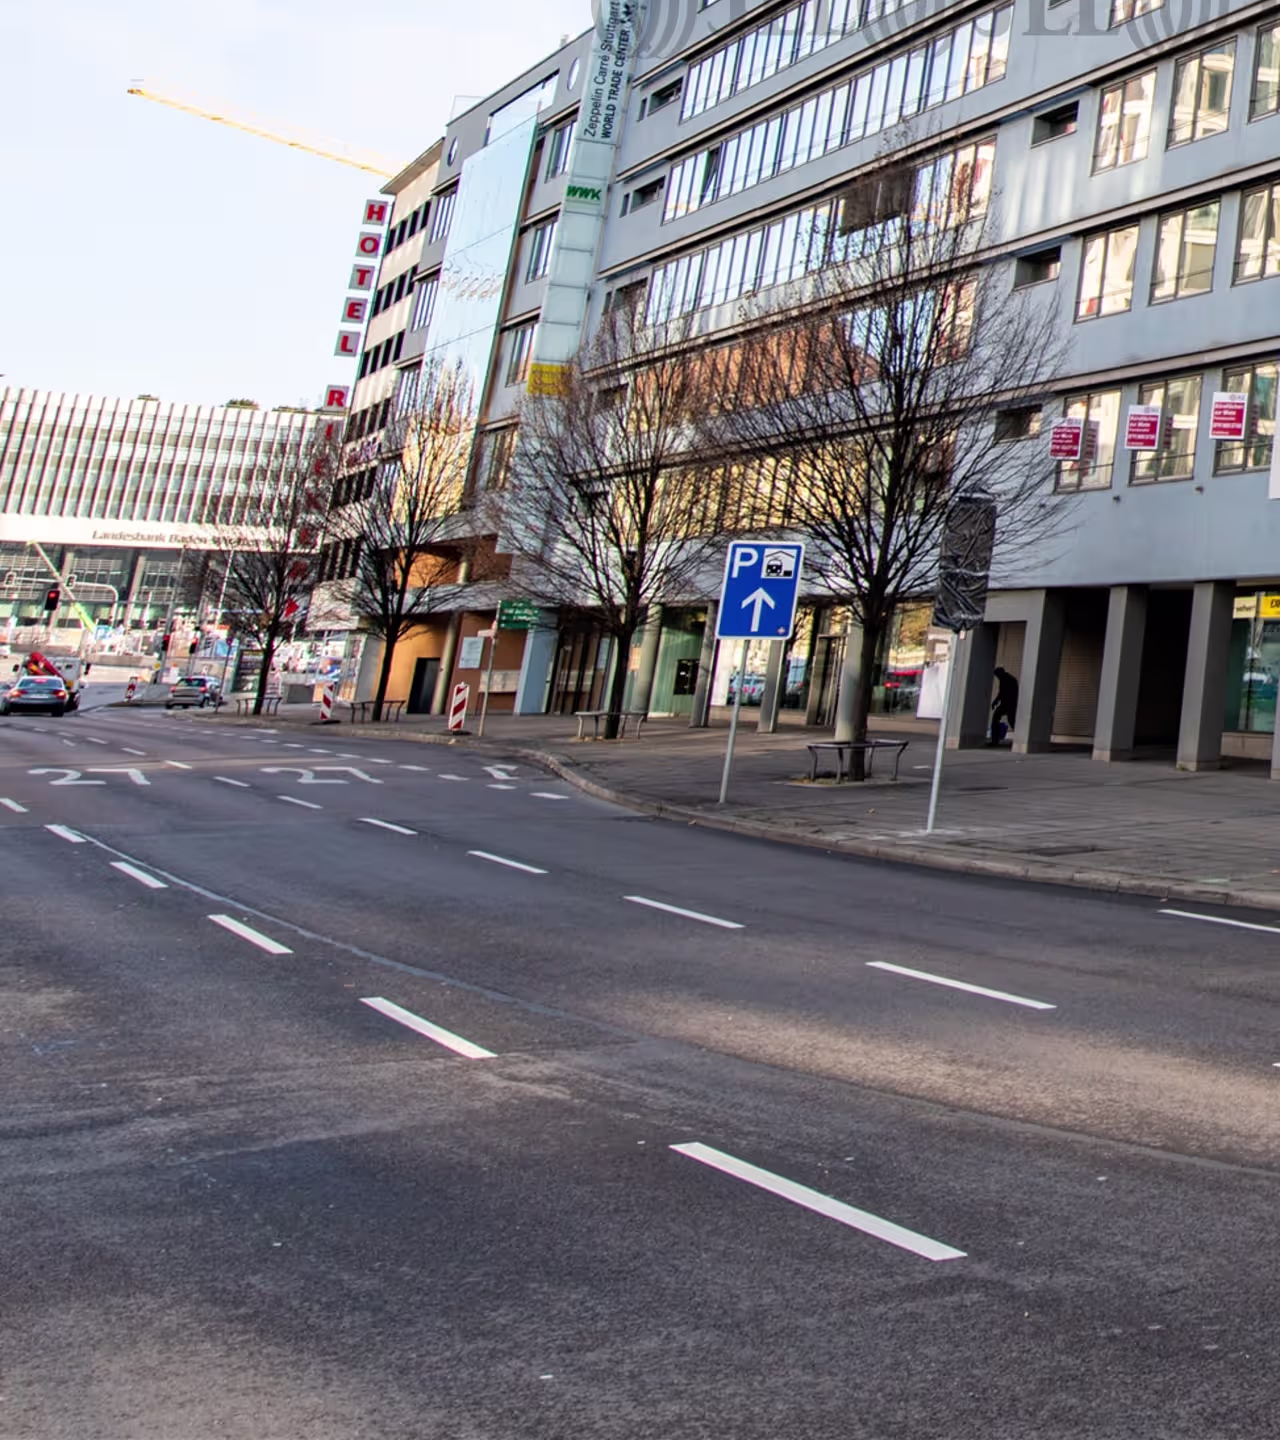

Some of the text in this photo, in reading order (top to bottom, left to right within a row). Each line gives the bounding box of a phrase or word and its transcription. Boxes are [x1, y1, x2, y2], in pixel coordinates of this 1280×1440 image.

[584, 86, 604, 137] Zeppelin
[601, 0, 620, 53] Stuttgart
[601, 29, 631, 139] WORLD TRADE CENTER
[340, 202, 386, 354] HOTEL
[731, 546, 759, 578] P
